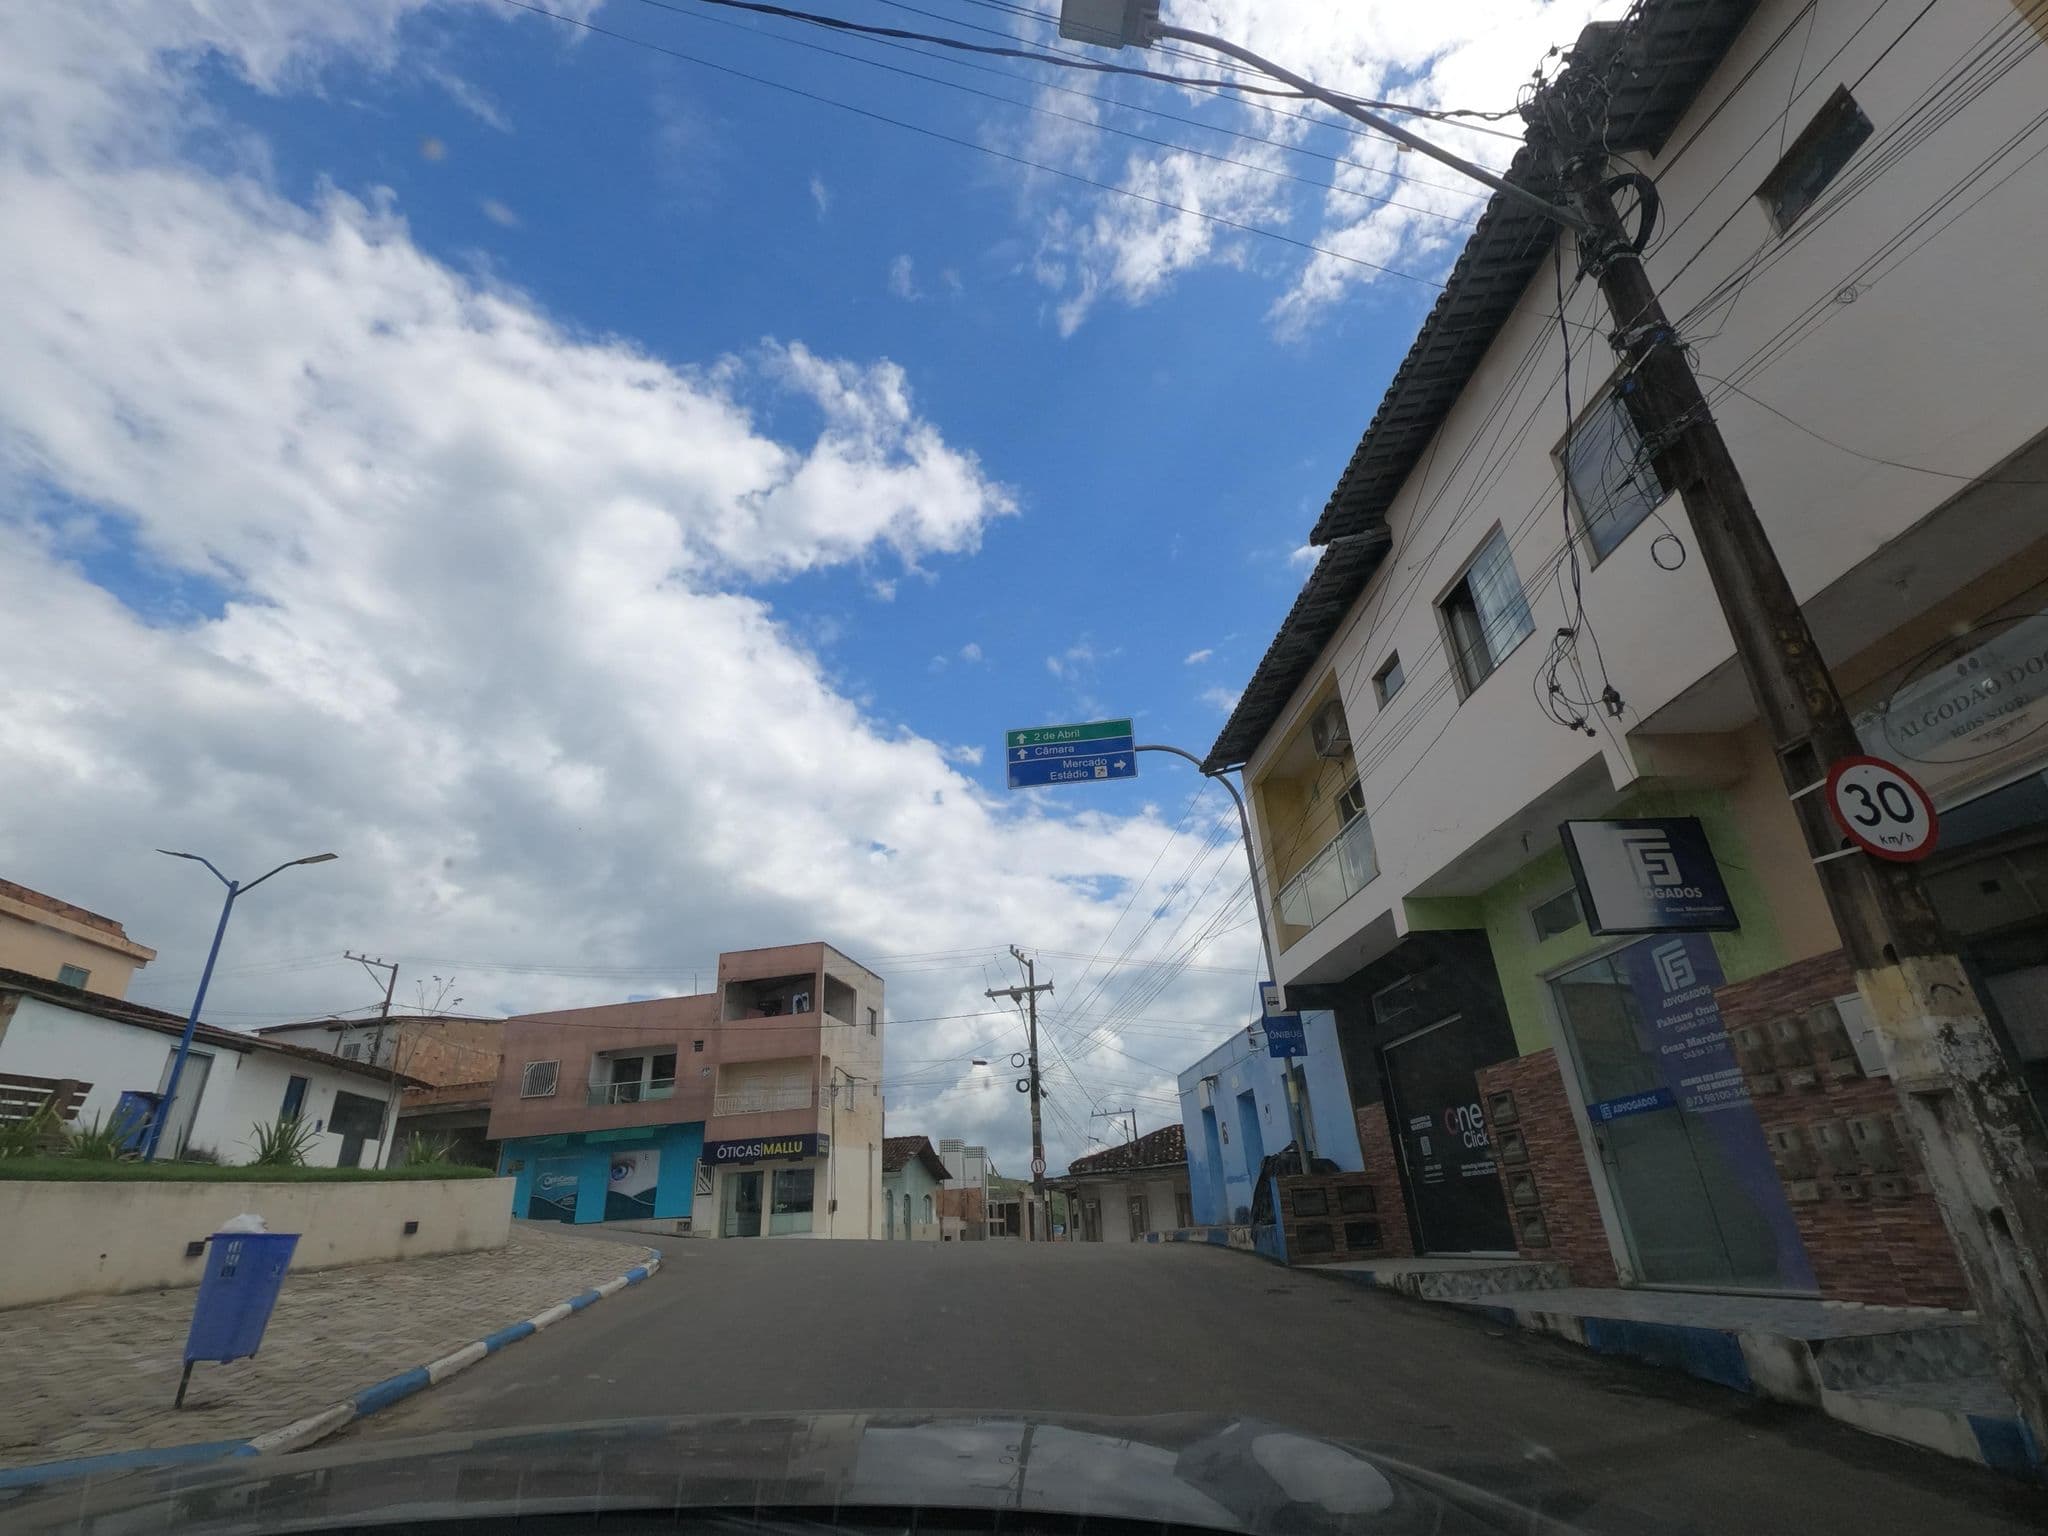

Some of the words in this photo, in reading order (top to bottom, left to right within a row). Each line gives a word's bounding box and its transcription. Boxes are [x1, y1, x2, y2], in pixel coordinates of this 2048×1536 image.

[1034, 733, 1041, 742] 2
[1043, 732, 1056, 741] de
[1057, 729, 1081, 740] Abril
[1034, 746, 1075, 756] Câmara
[1063, 757, 1108, 769] Mercado
[1050, 770, 1089, 781] Estádio
[1844, 780, 1915, 827] 30
[1879, 832, 1914, 846] km/h
[1663, 985, 1712, 1009] ADVOGADOS
[1656, 1011, 1694, 1029] Fabiano
[1269, 1030, 1303, 1040] ÔNIBUS
[1613, 1096, 1658, 1113] ADVOGADOS
[1463, 1129, 1490, 1148] Click
[717, 1145, 761, 1159] ÓTICAS
[763, 1141, 803, 1155] MALLU
